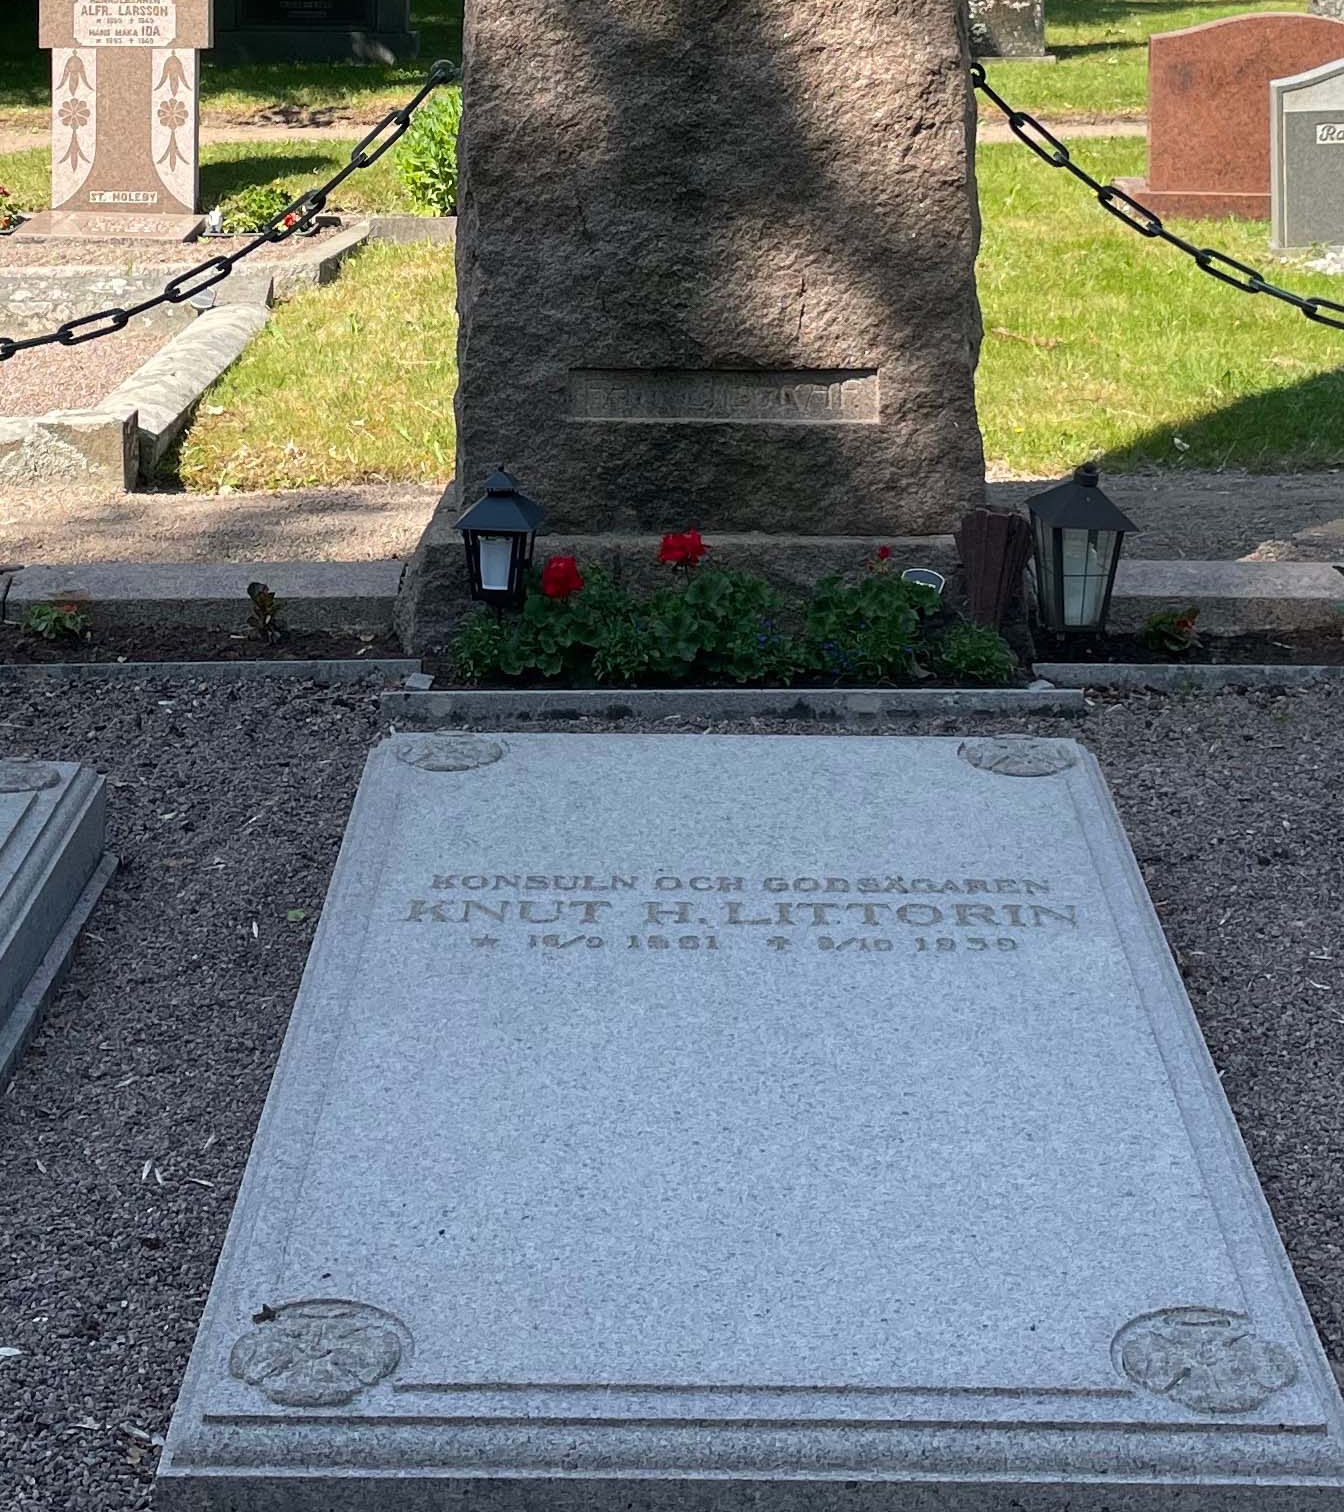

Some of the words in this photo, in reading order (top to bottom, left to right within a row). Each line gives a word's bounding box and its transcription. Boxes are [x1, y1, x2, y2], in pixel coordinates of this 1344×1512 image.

[80, 5, 112, 16] ALFR.
[119, 5, 168, 16] LARSSON
[115, 29, 138, 37] MAKA
[142, 25, 161, 37] IDA
[431, 874, 640, 891] KONSULN
[654, 875, 745, 892] OCH
[763, 876, 1050, 895] GODSÄGAREN
[402, 899, 613, 925] KNUT
[642, 900, 709, 926] H.
[720, 901, 1079, 929] LITTORIN
